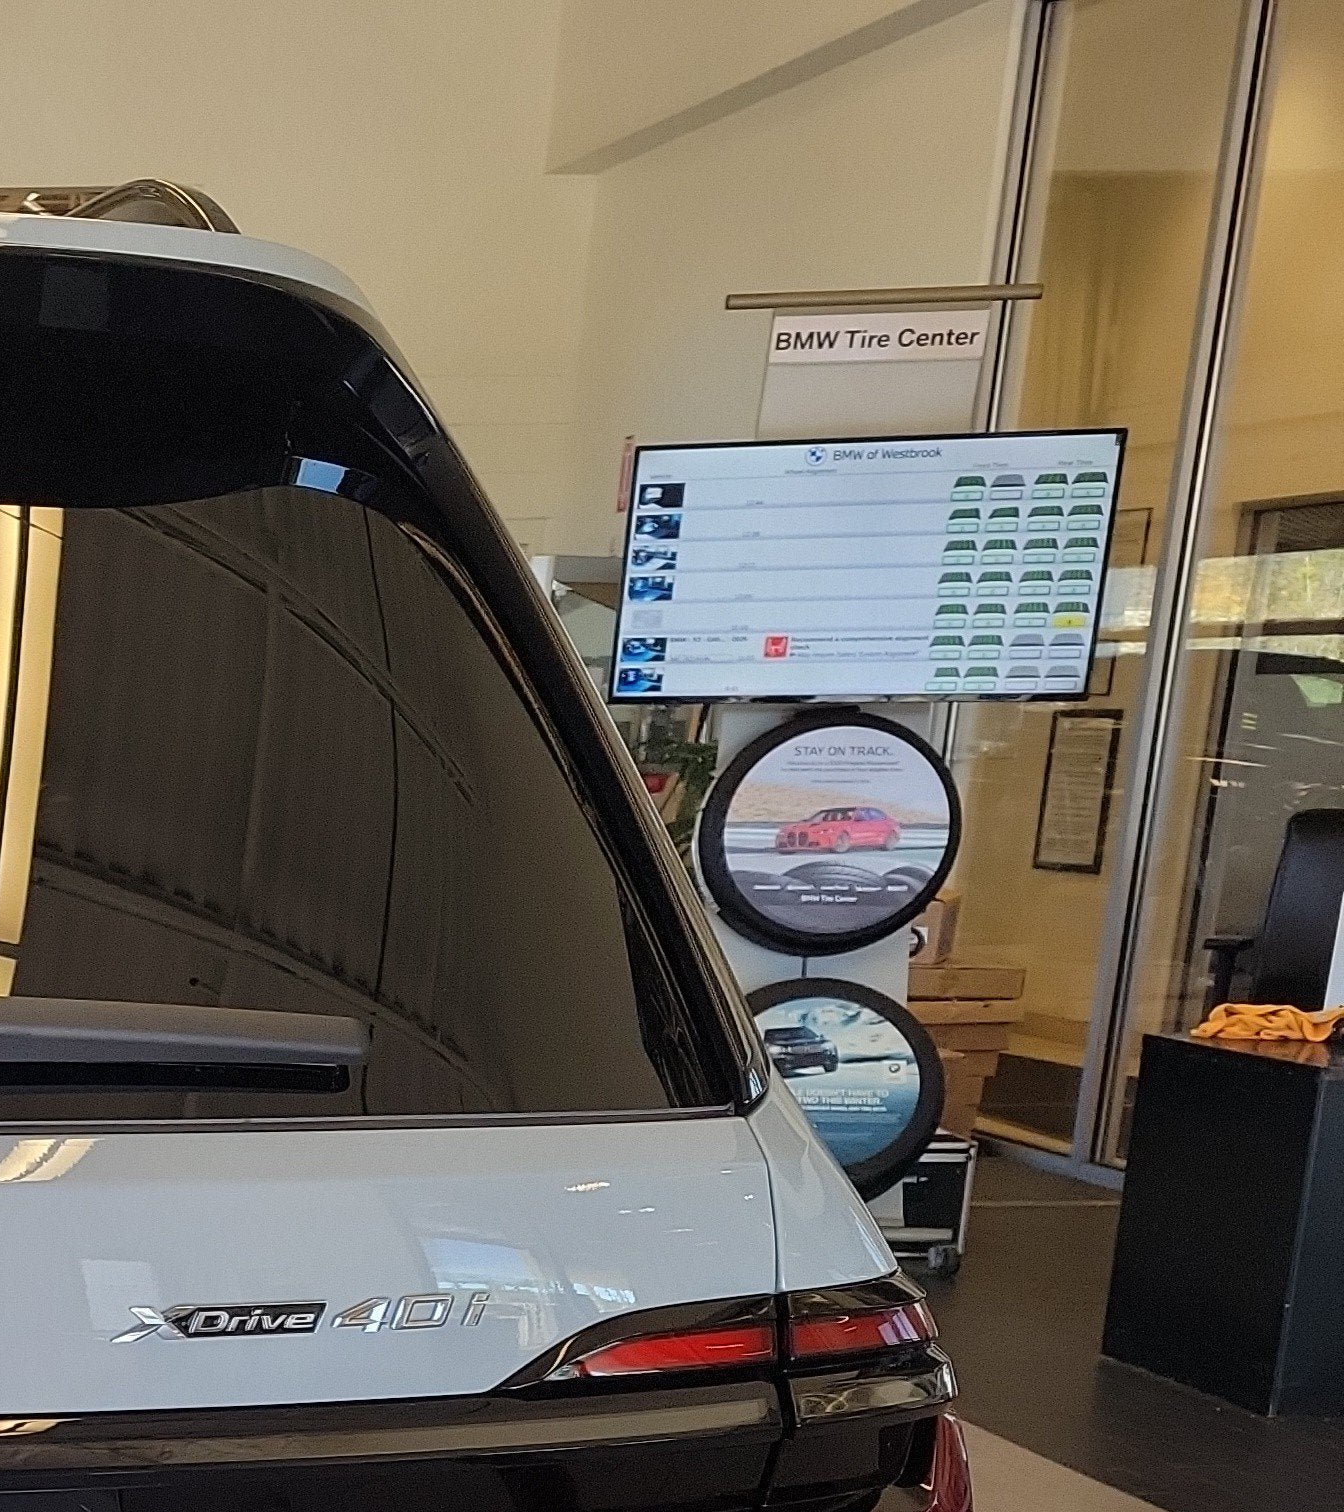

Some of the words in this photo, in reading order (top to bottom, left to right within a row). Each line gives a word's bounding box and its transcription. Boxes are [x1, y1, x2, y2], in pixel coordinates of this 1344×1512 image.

[775, 330, 839, 351] BMW
[845, 329, 891, 349] Tire
[898, 327, 980, 348] Center
[833, 449, 863, 461] BMW
[866, 448, 879, 460] of
[881, 447, 942, 460] Westbrook
[794, 746, 823, 757] STAY
[827, 746, 845, 757] ON
